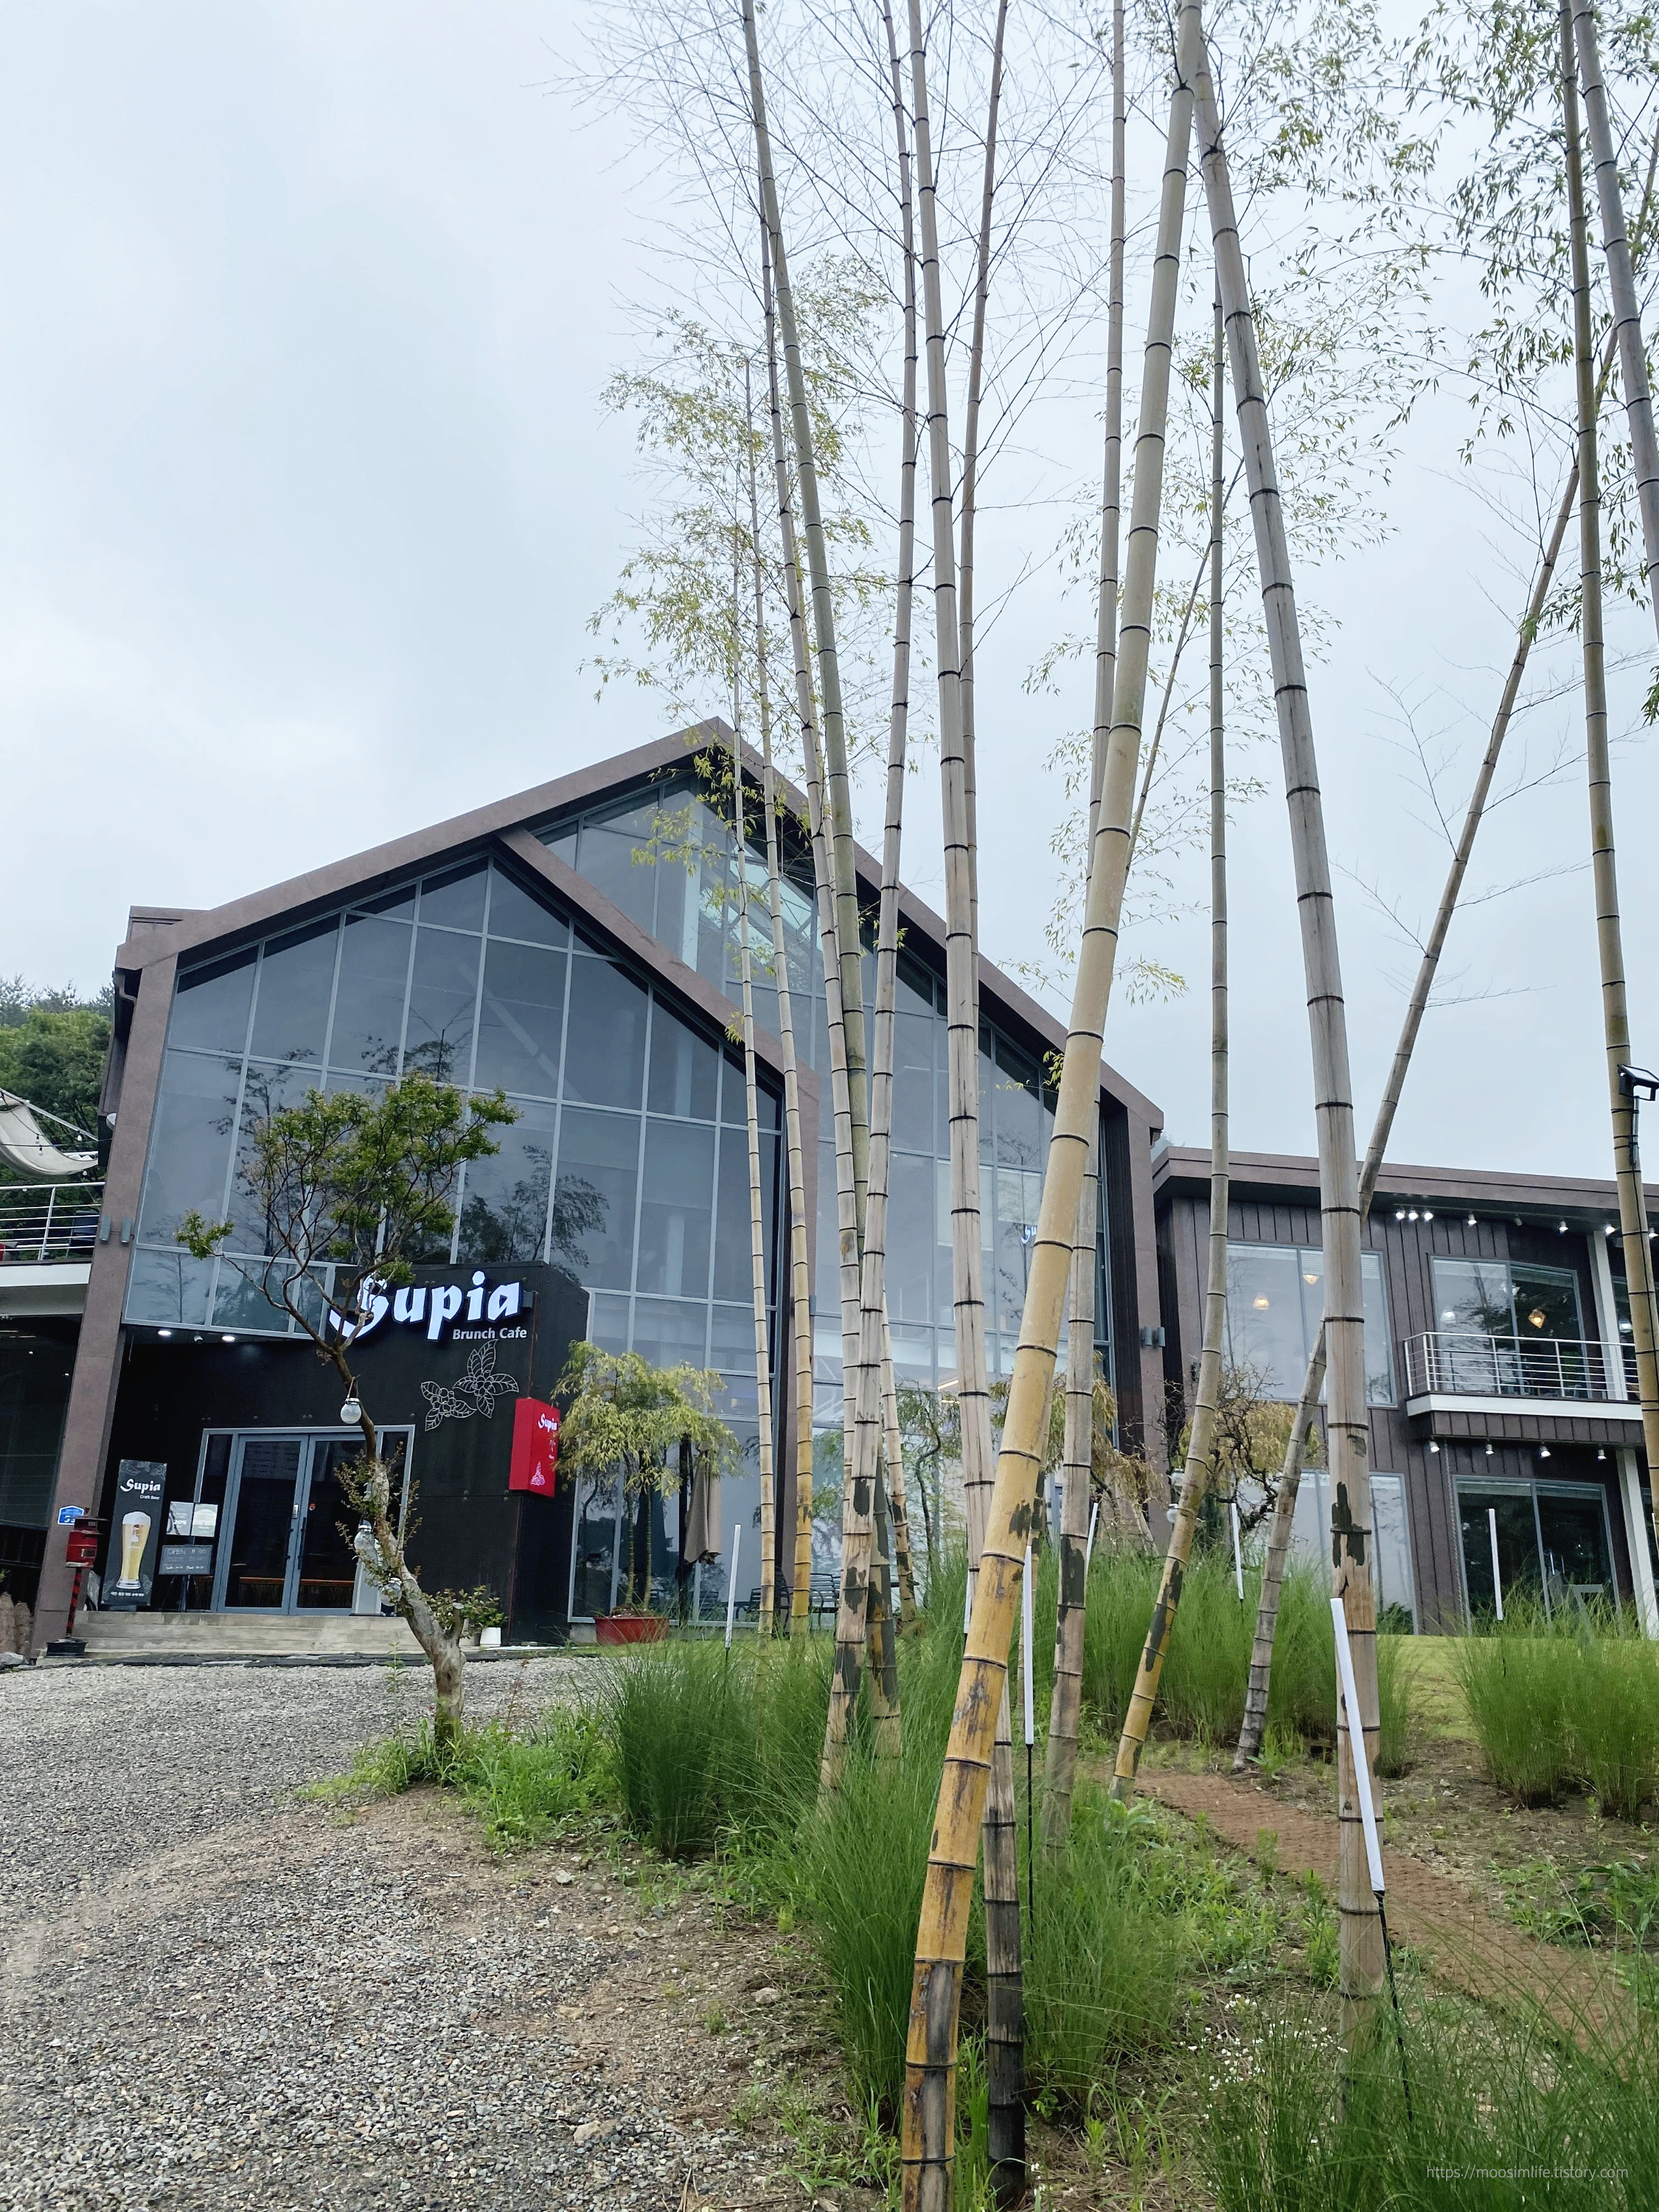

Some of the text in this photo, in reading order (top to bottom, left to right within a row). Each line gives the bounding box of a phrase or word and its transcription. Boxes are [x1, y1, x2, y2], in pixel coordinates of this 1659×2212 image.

[329, 1270, 520, 1341] Supia
[453, 1326, 527, 1340] Brunch Cafe
[538, 1413, 557, 1433] Supia
[120, 1478, 161, 1495] Supia
